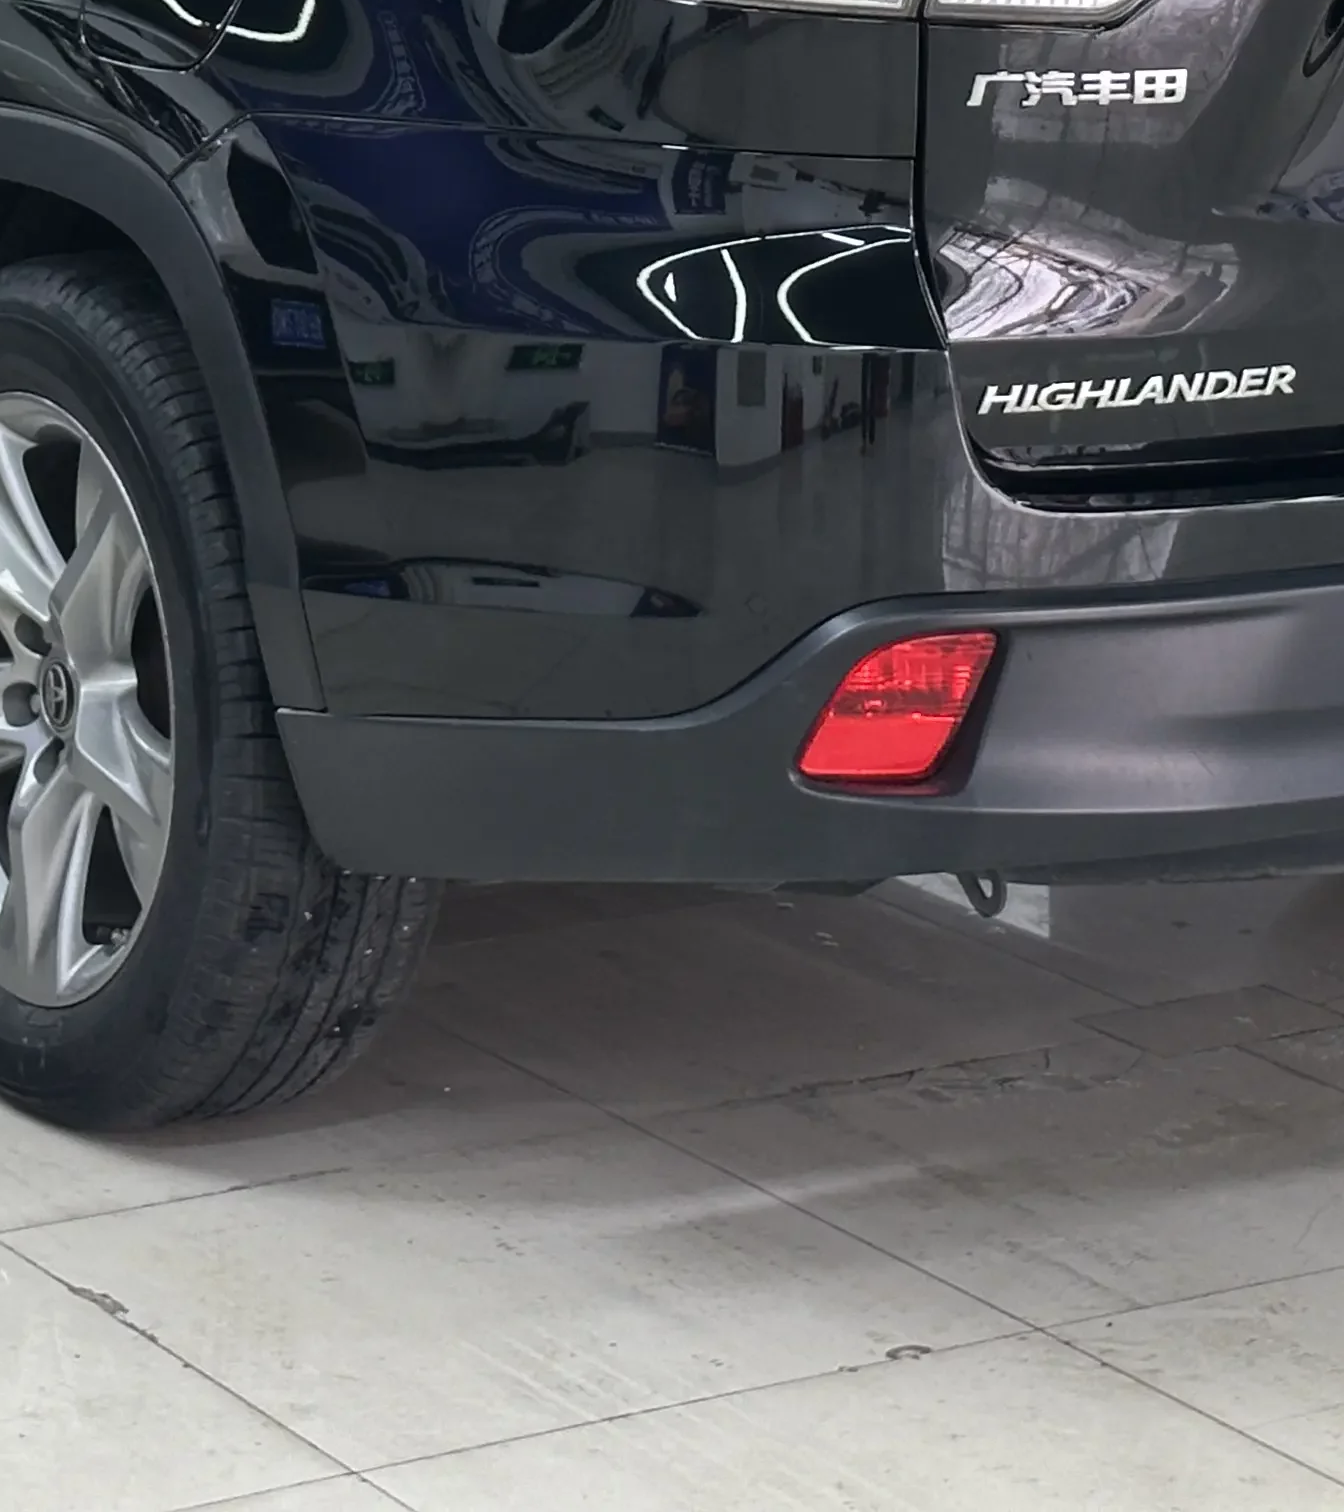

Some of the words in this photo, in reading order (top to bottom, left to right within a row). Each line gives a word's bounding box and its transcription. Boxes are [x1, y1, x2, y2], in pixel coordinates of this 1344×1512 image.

[966, 68, 1188, 107] 广汽丰田
[977, 364, 1297, 415] HIGHLANDER
